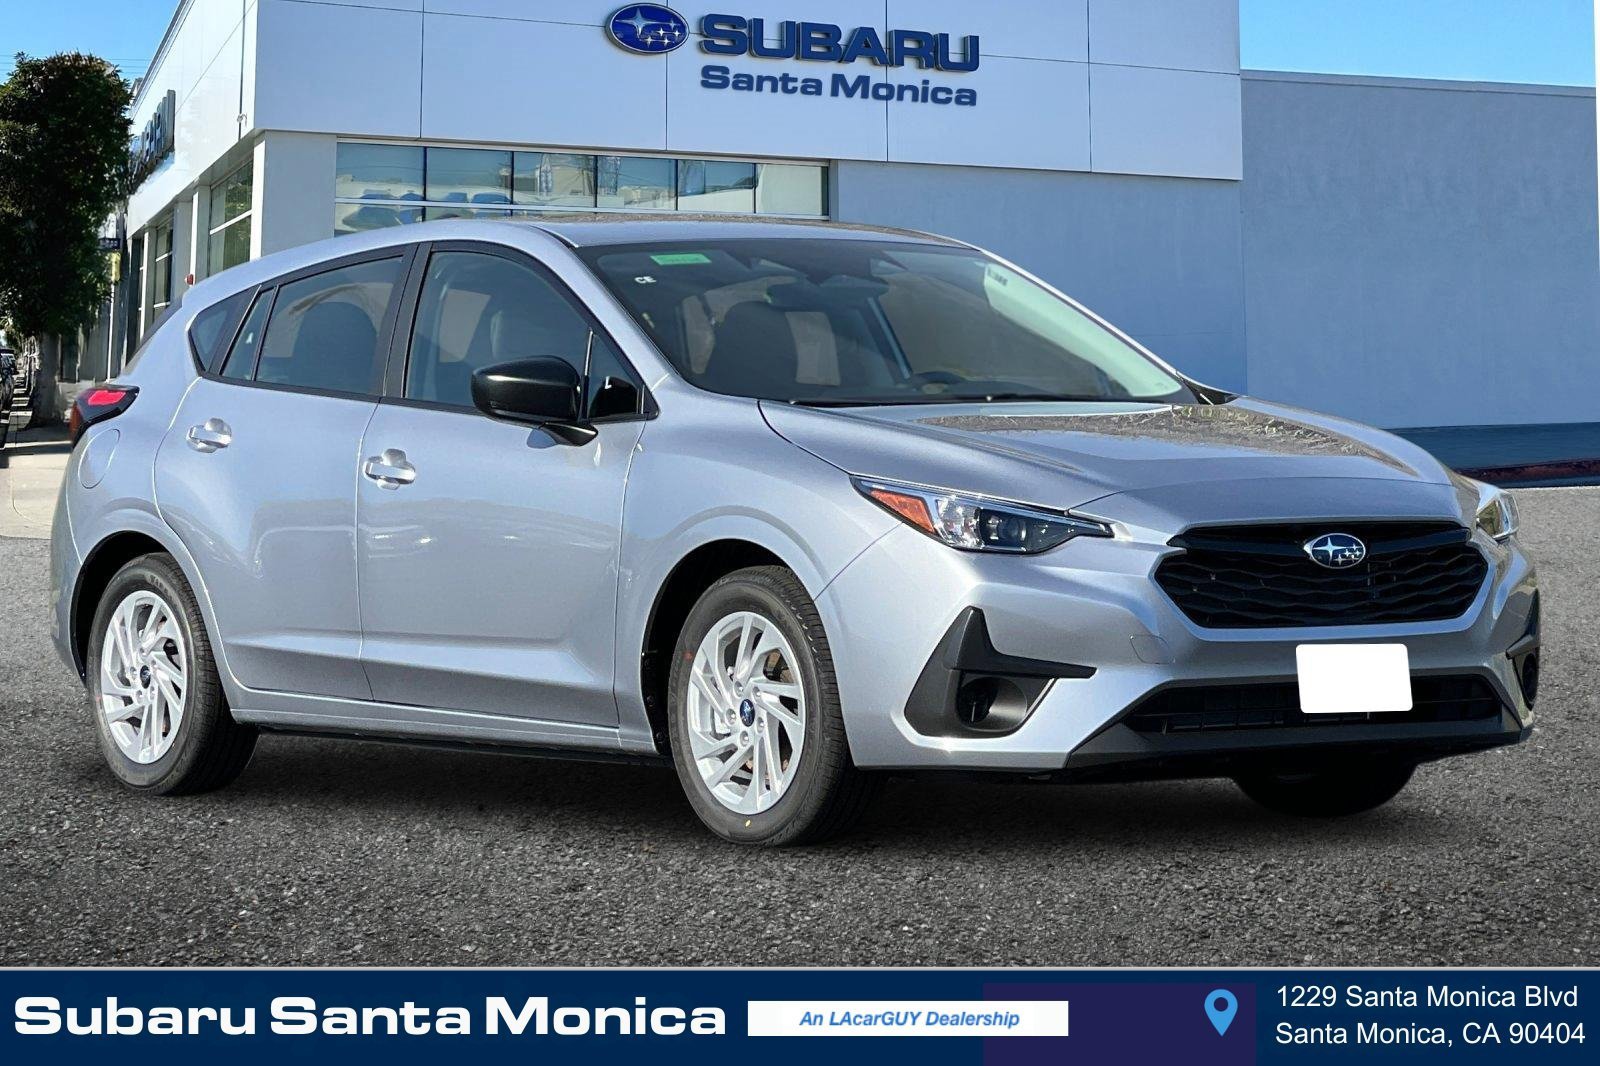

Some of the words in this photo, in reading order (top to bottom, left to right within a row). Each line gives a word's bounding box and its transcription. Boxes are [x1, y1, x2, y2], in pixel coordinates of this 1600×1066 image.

[701, 13, 979, 72] SUBARU
[700, 65, 822, 97] Santa
[830, 74, 978, 107] Monica
